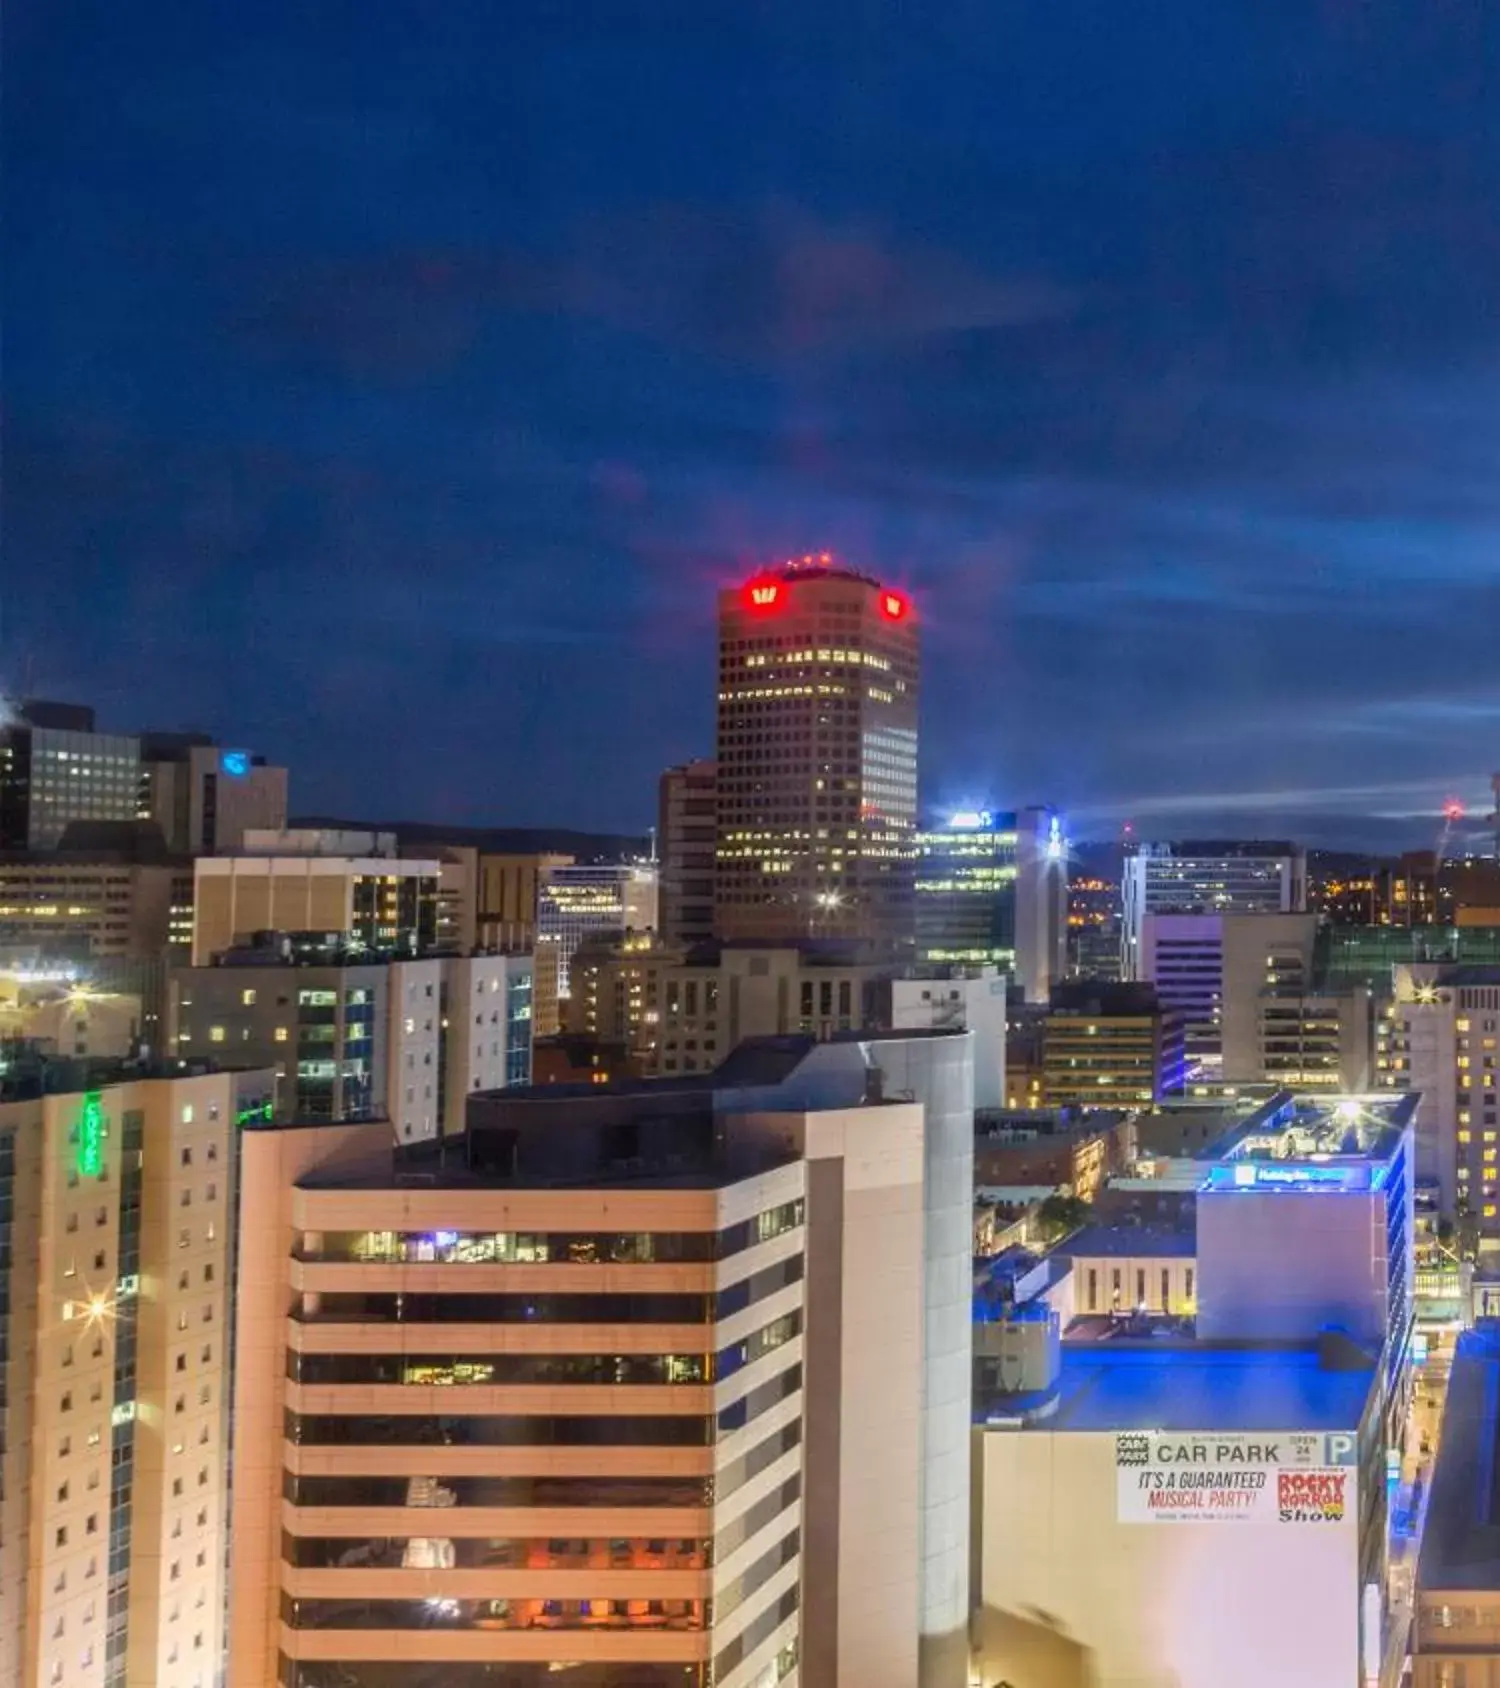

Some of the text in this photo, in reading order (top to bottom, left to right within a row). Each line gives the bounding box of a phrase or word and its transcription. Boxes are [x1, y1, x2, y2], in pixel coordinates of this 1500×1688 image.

[1157, 1445, 1280, 1463] CAR PARK
[1330, 1436, 1352, 1464] P
[1138, 1471, 1267, 1489] IT'S A GUARANTEED
[1278, 1473, 1347, 1494] ROCKY
[1147, 1490, 1205, 1509] MUSICAL
[1279, 1507, 1344, 1523] Show
